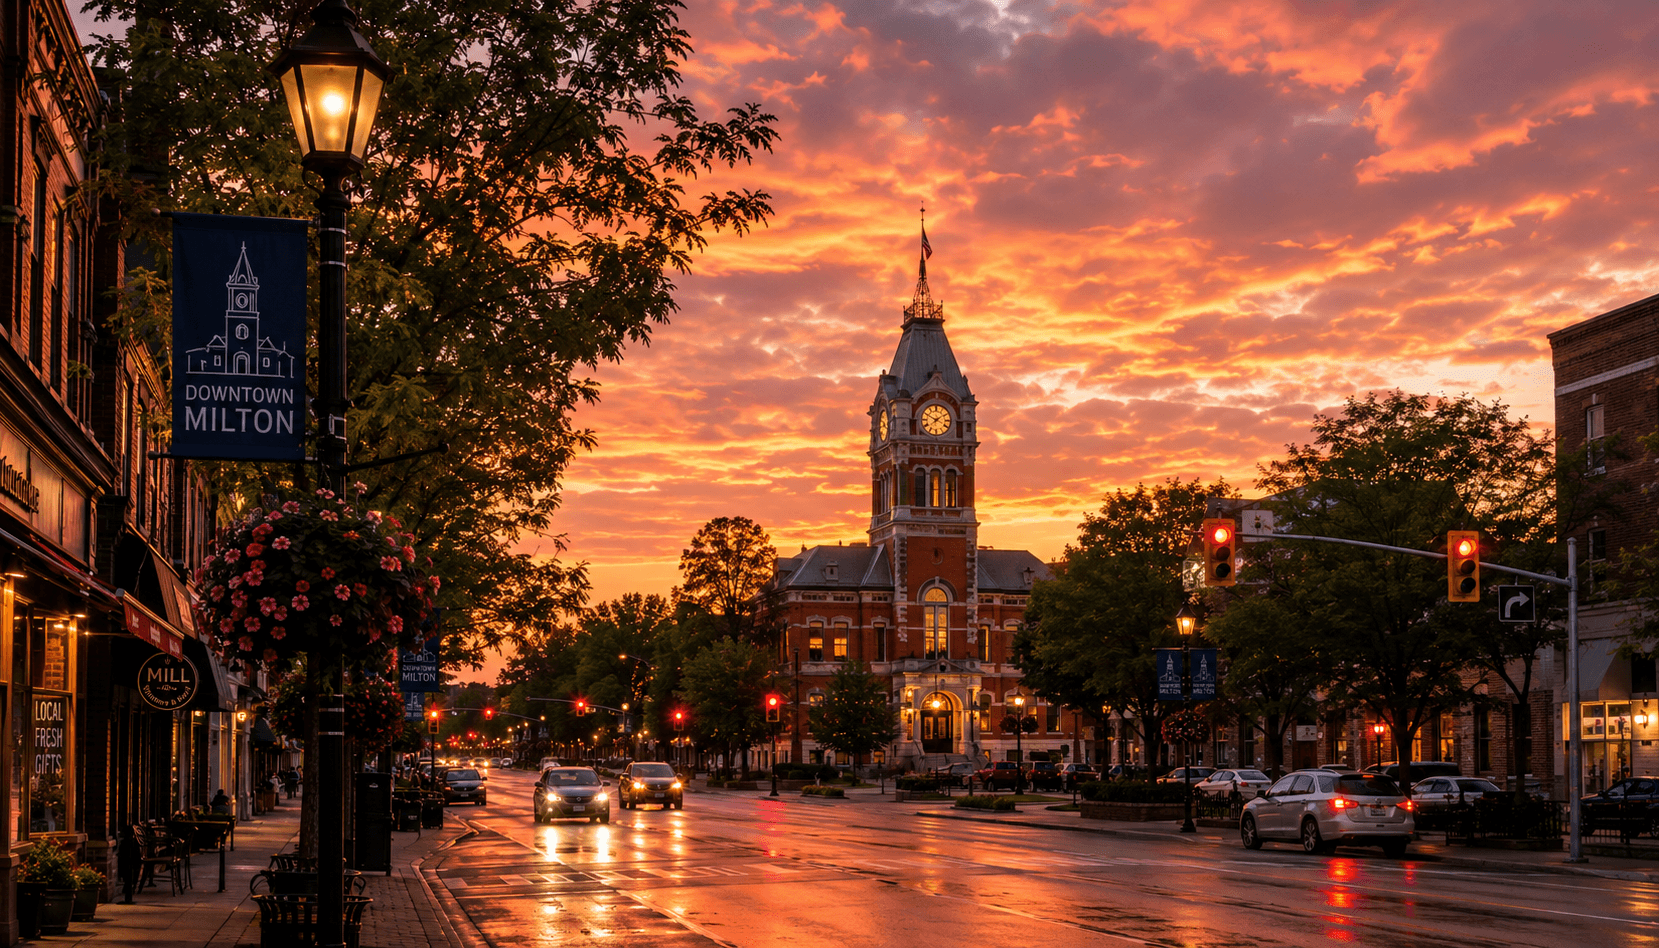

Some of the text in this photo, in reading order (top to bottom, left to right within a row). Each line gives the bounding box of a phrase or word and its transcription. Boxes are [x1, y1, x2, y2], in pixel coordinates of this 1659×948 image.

[185, 384, 294, 404] DOWNTOWN
[185, 405, 294, 434] MILTON
[147, 667, 190, 683] MILL
[402, 672, 436, 682] MILTON
[35, 700, 63, 721] LOCAL
[35, 727, 63, 748] FRESH
[35, 753, 62, 775] GIFTS
